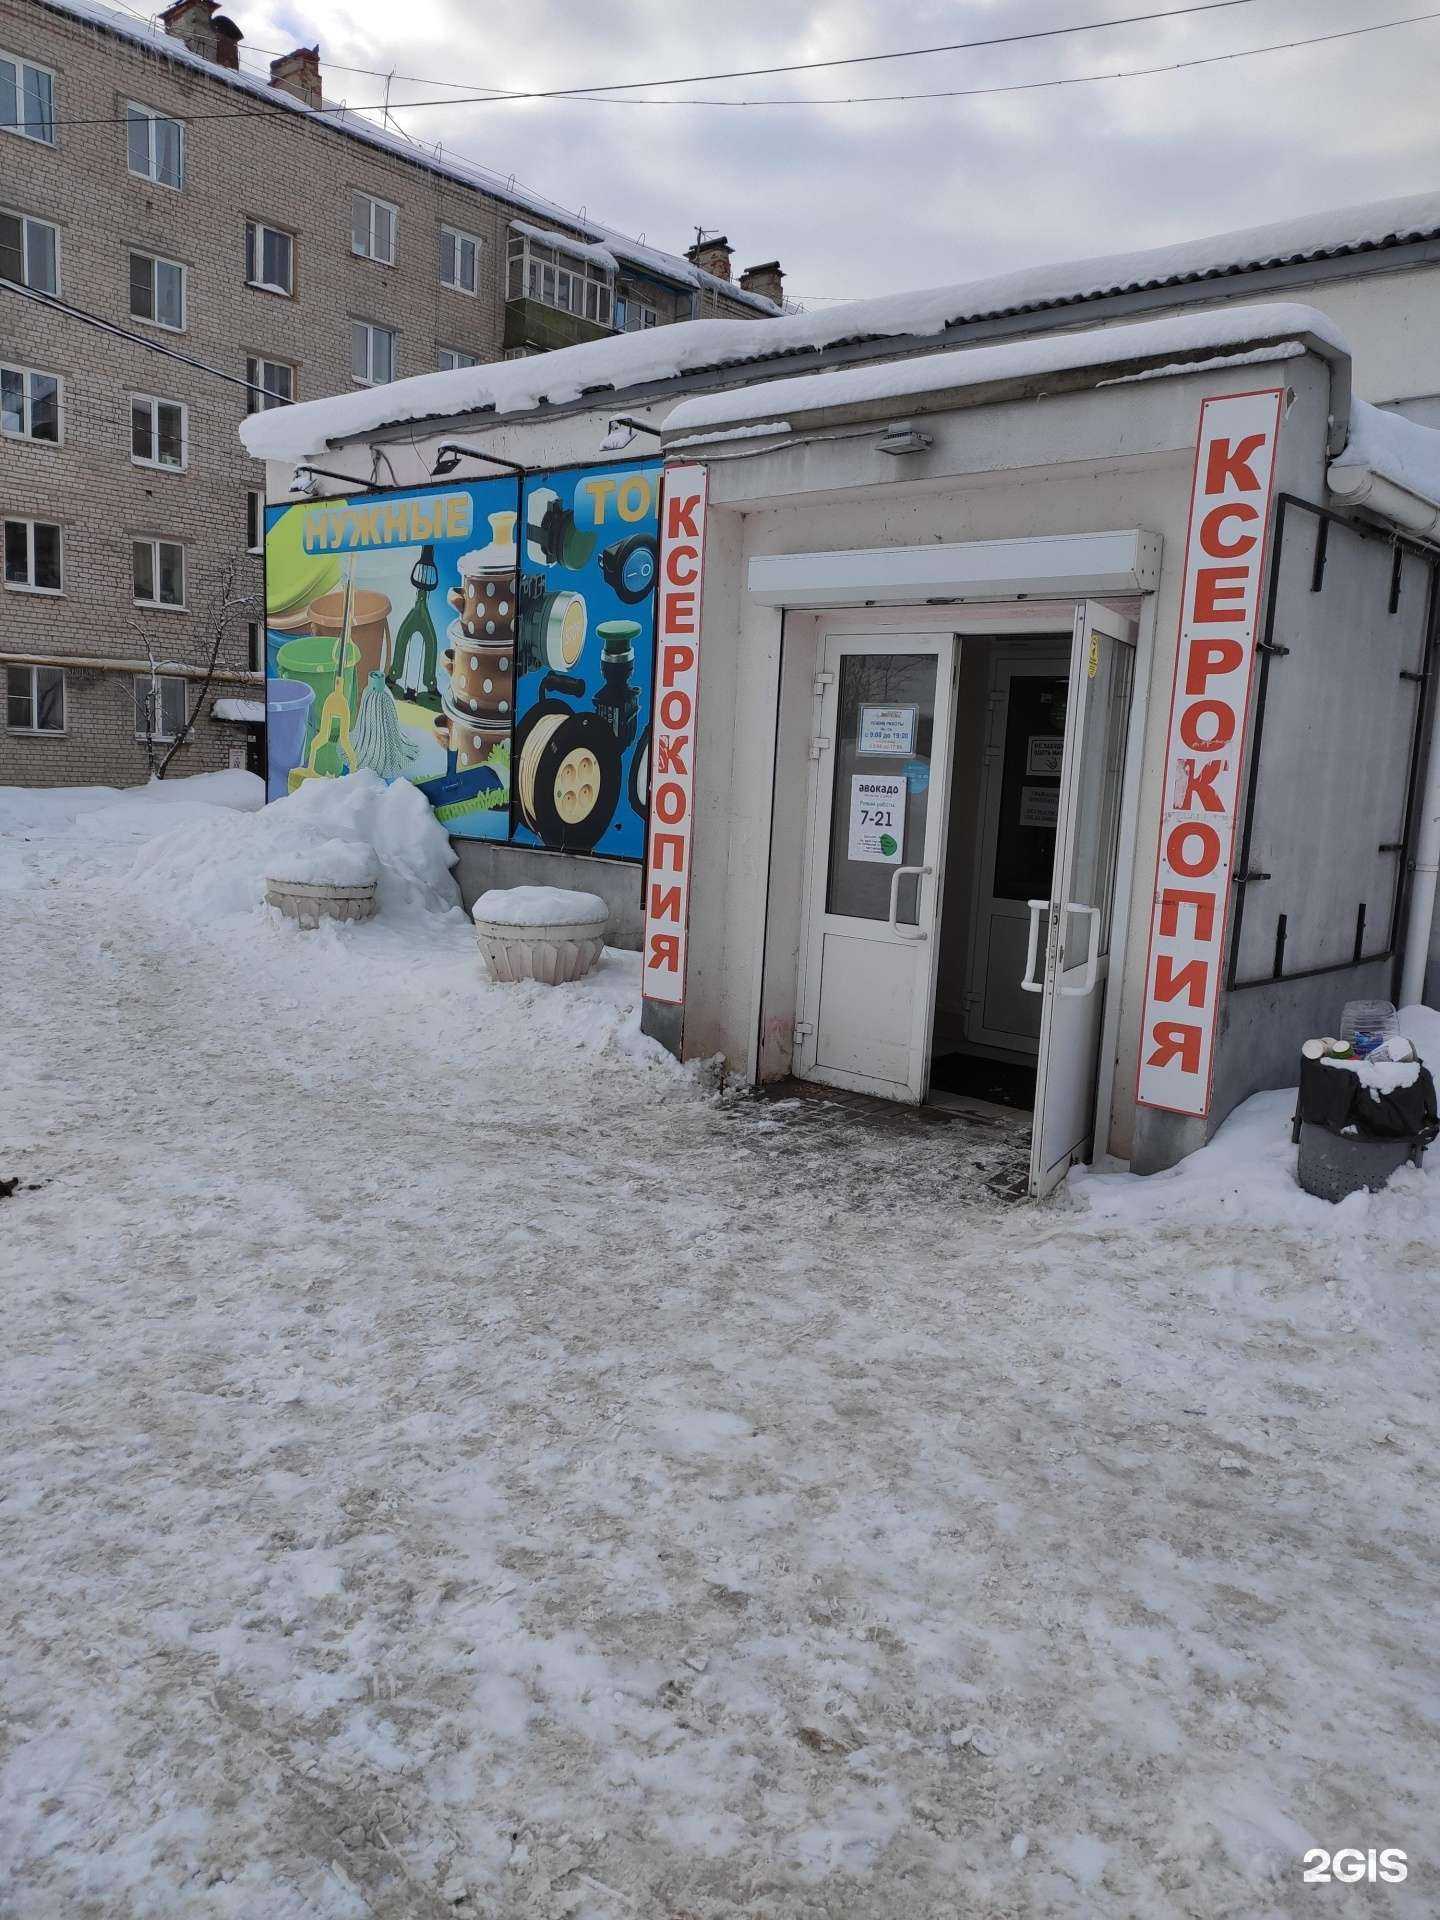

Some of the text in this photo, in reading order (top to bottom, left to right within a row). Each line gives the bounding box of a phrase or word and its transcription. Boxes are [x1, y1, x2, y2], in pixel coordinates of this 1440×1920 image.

[305, 473, 660, 550] НУЖНЫЕ ТО
[647, 494, 701, 973] КСЕРОКОПИЯ
[860, 809, 893, 827] 7-21
[1147, 433, 1266, 1074] КСЕРОКОПИЯ
